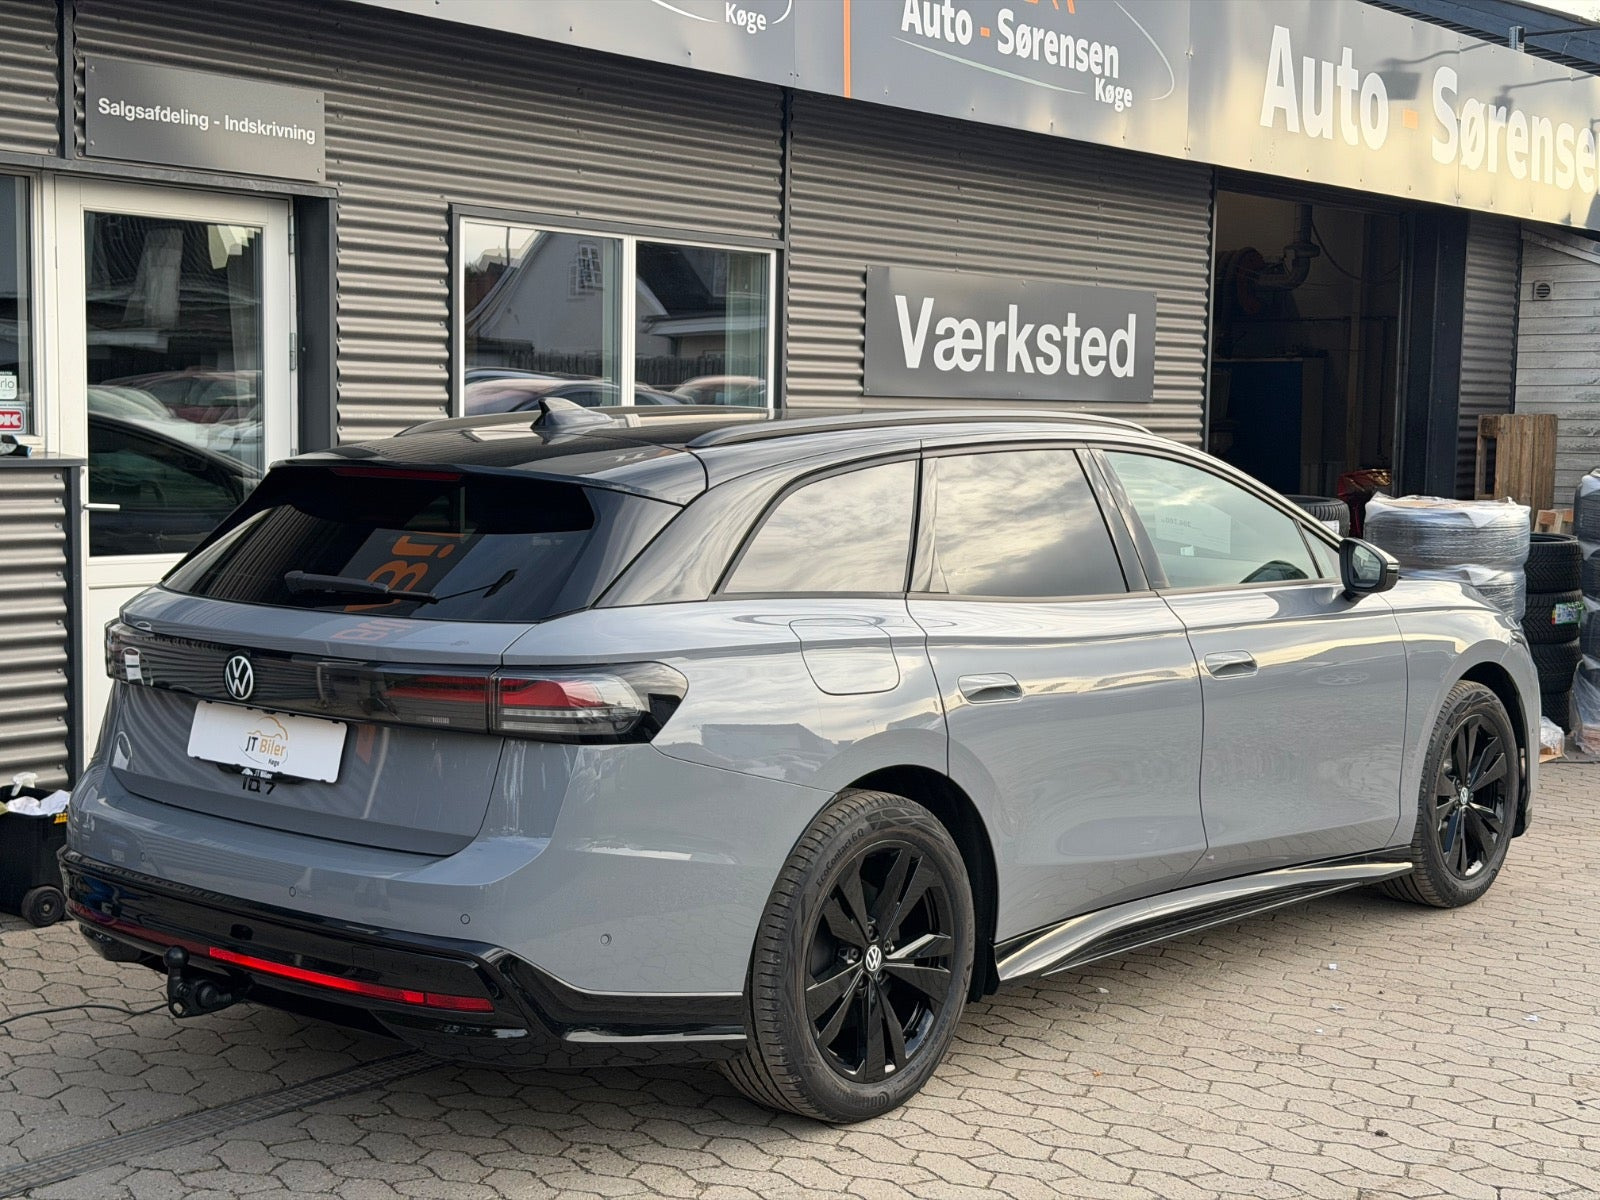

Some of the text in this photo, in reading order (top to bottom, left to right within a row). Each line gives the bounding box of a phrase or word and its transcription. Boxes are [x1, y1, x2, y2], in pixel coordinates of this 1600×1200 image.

[725, 2, 767, 34] Køge
[901, 0, 973, 46] Auto
[997, 9, 1119, 78] Sørensen
[1095, 77, 1133, 111] Køge
[1259, 24, 1389, 150] Auto
[1432, 66, 1600, 193] Sørense
[98, 97, 209, 131] Salgsafdeling
[224, 115, 316, 145] Indskrivning
[894, 294, 1137, 378] Værksted
[245, 736, 287, 757] JT Biler
